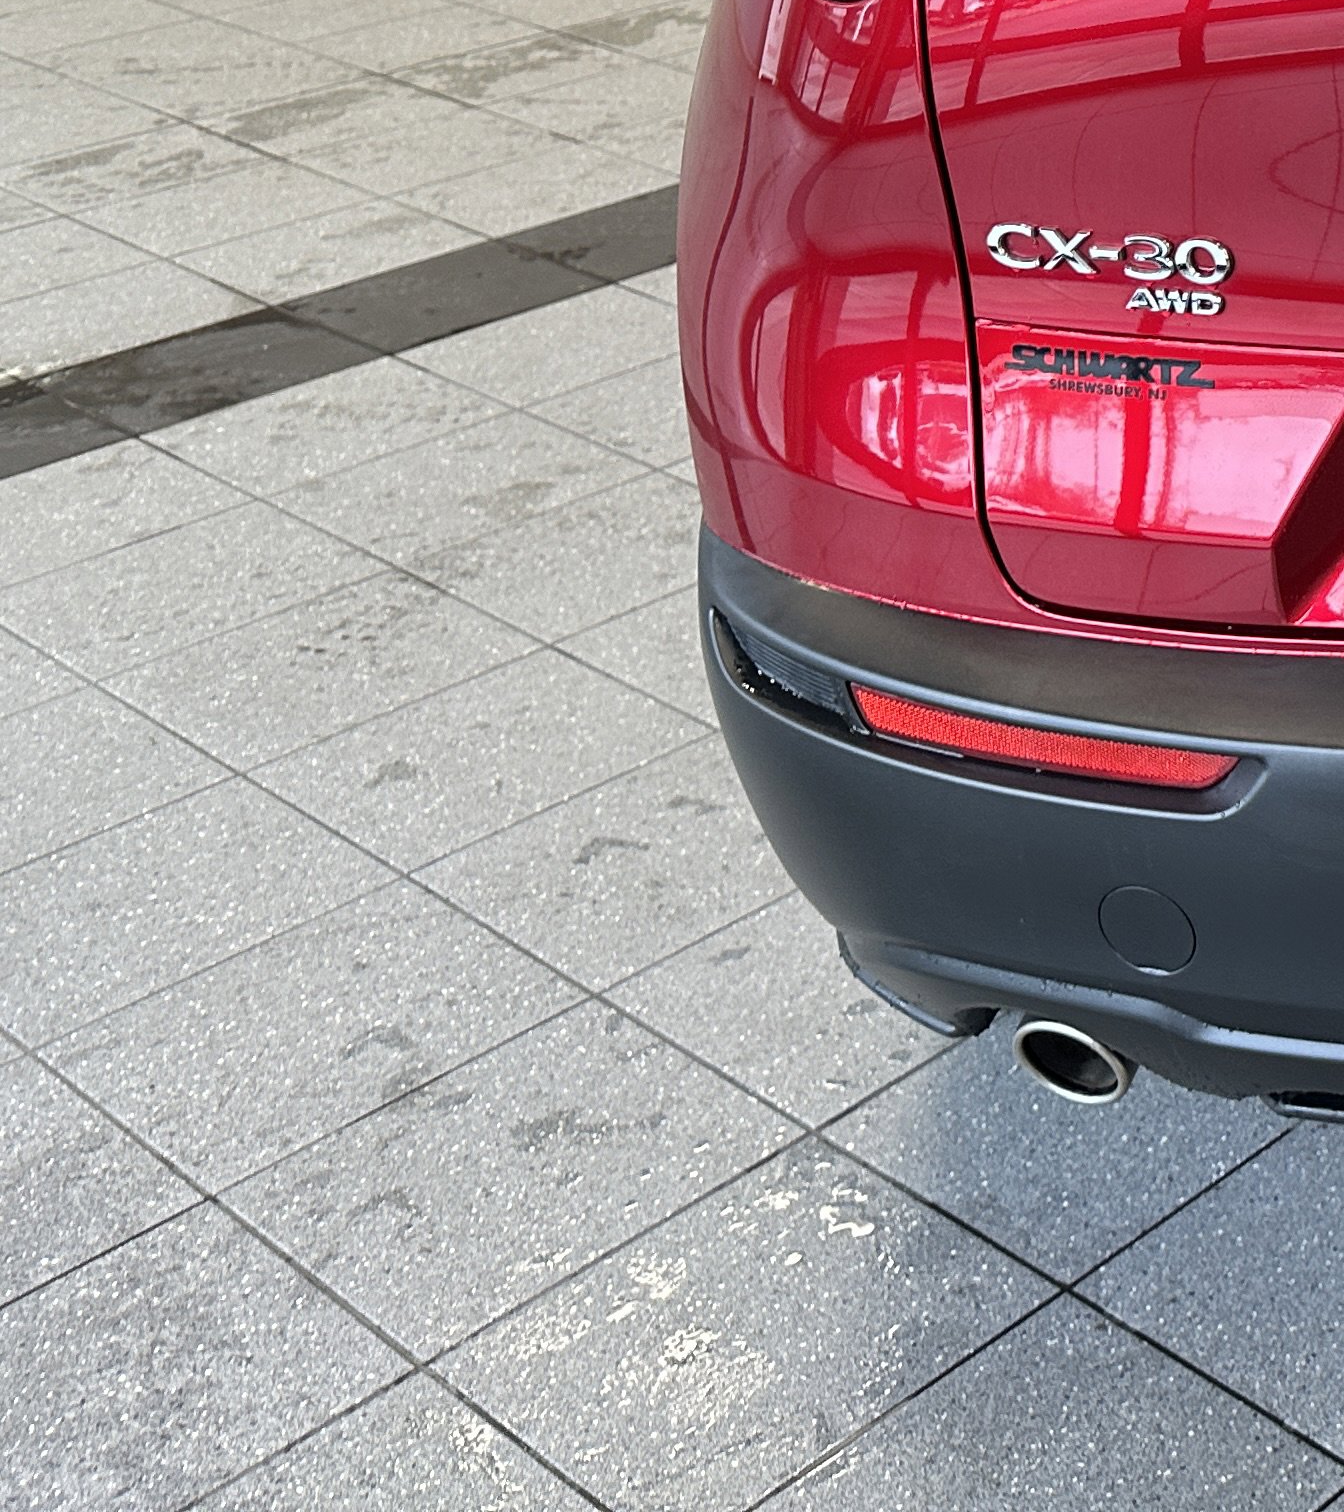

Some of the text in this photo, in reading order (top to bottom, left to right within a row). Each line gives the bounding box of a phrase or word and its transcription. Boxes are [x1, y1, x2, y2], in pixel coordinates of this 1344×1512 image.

[986, 222, 1234, 286] CX-30
[1125, 287, 1225, 317] AWD
[1004, 343, 1216, 390] SCHWARTZ
[1049, 378, 1168, 401] SHREWSBURY, NJ
